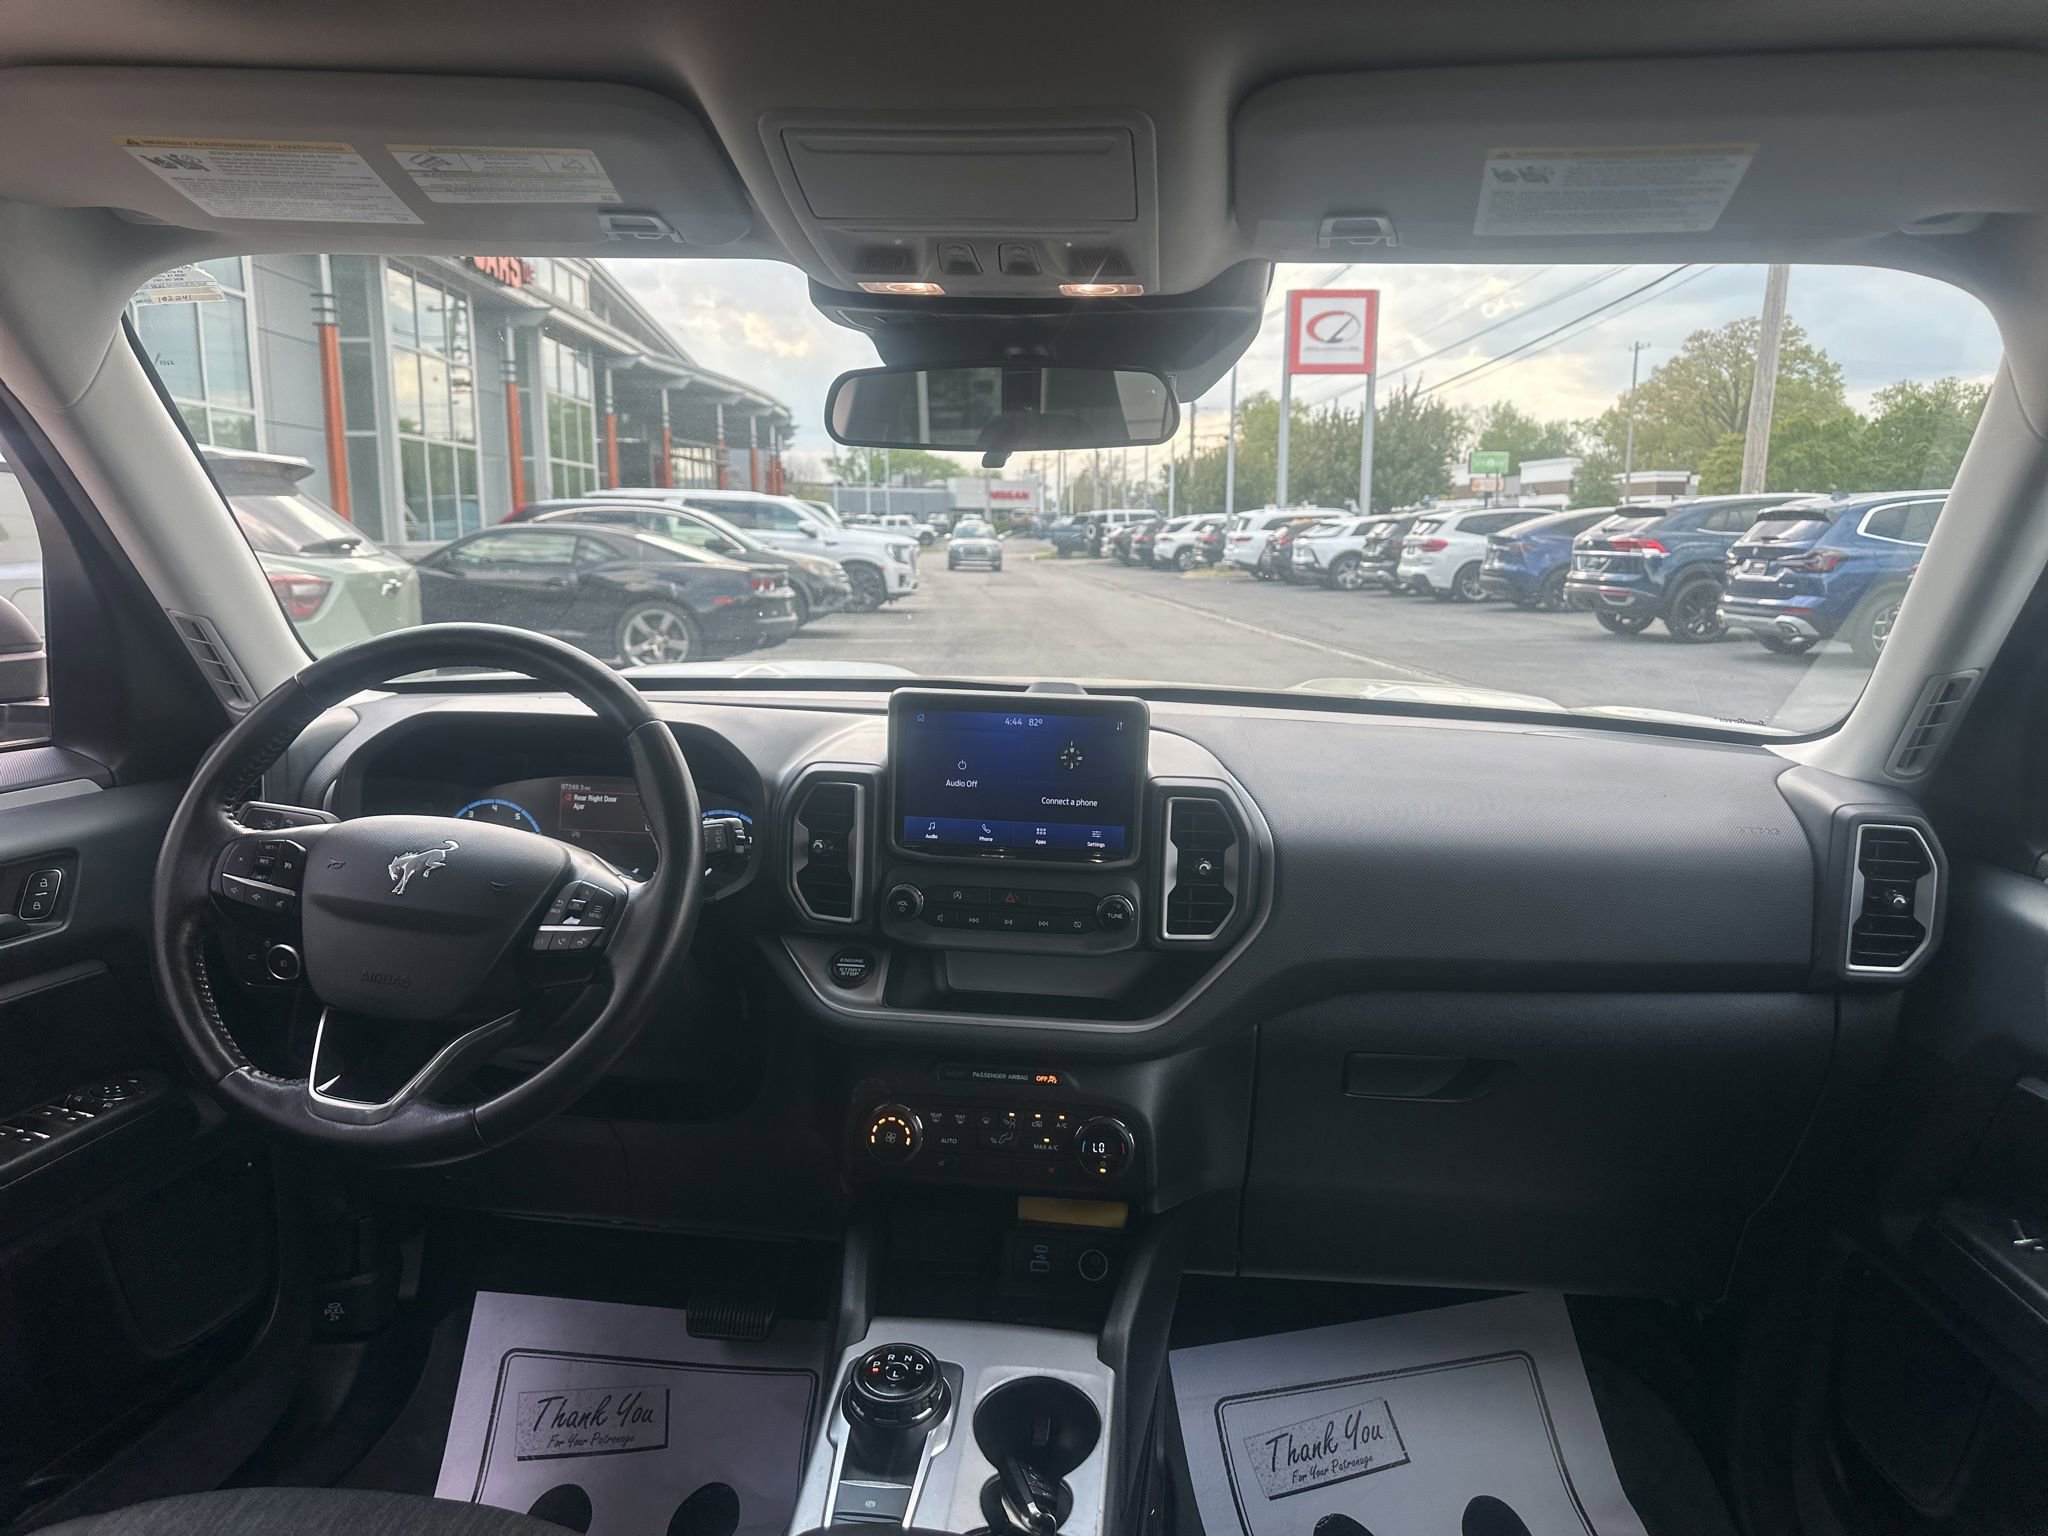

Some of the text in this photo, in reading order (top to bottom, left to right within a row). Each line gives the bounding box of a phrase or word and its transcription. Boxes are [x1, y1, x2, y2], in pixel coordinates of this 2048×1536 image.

[1004, 717, 1023, 726] 4:44
[945, 779, 978, 788] Audio Off
[573, 794, 587, 802] Rear
[588, 795, 603, 804] Right
[1041, 796, 1069, 806] Connect
[1075, 798, 1098, 808] phone
[491, 804, 498, 812] 4
[573, 803, 586, 811] Ajar
[468, 810, 474, 818] 3
[514, 812, 521, 820] 5
[896, 899, 909, 907] VOL
[1107, 912, 1123, 920] TUNE
[360, 968, 411, 989] AIRBAG
[972, 1071, 1007, 1080] PASSENGER
[1008, 1073, 1029, 1082] AIRBAG
[1056, 1121, 1068, 1129] A/C
[940, 1137, 958, 1145] AUTO
[887, 1353, 896, 1361] R
[904, 1354, 913, 1362] N
[872, 1360, 881, 1368] P
[915, 1363, 924, 1371] D
[892, 1370, 899, 1378] L
[533, 1391, 655, 1432] Thank You
[547, 1431, 636, 1449] For Your Patronage
[1265, 1410, 1384, 1472] Thank You
[1292, 1455, 1374, 1485] For Your Patronage
